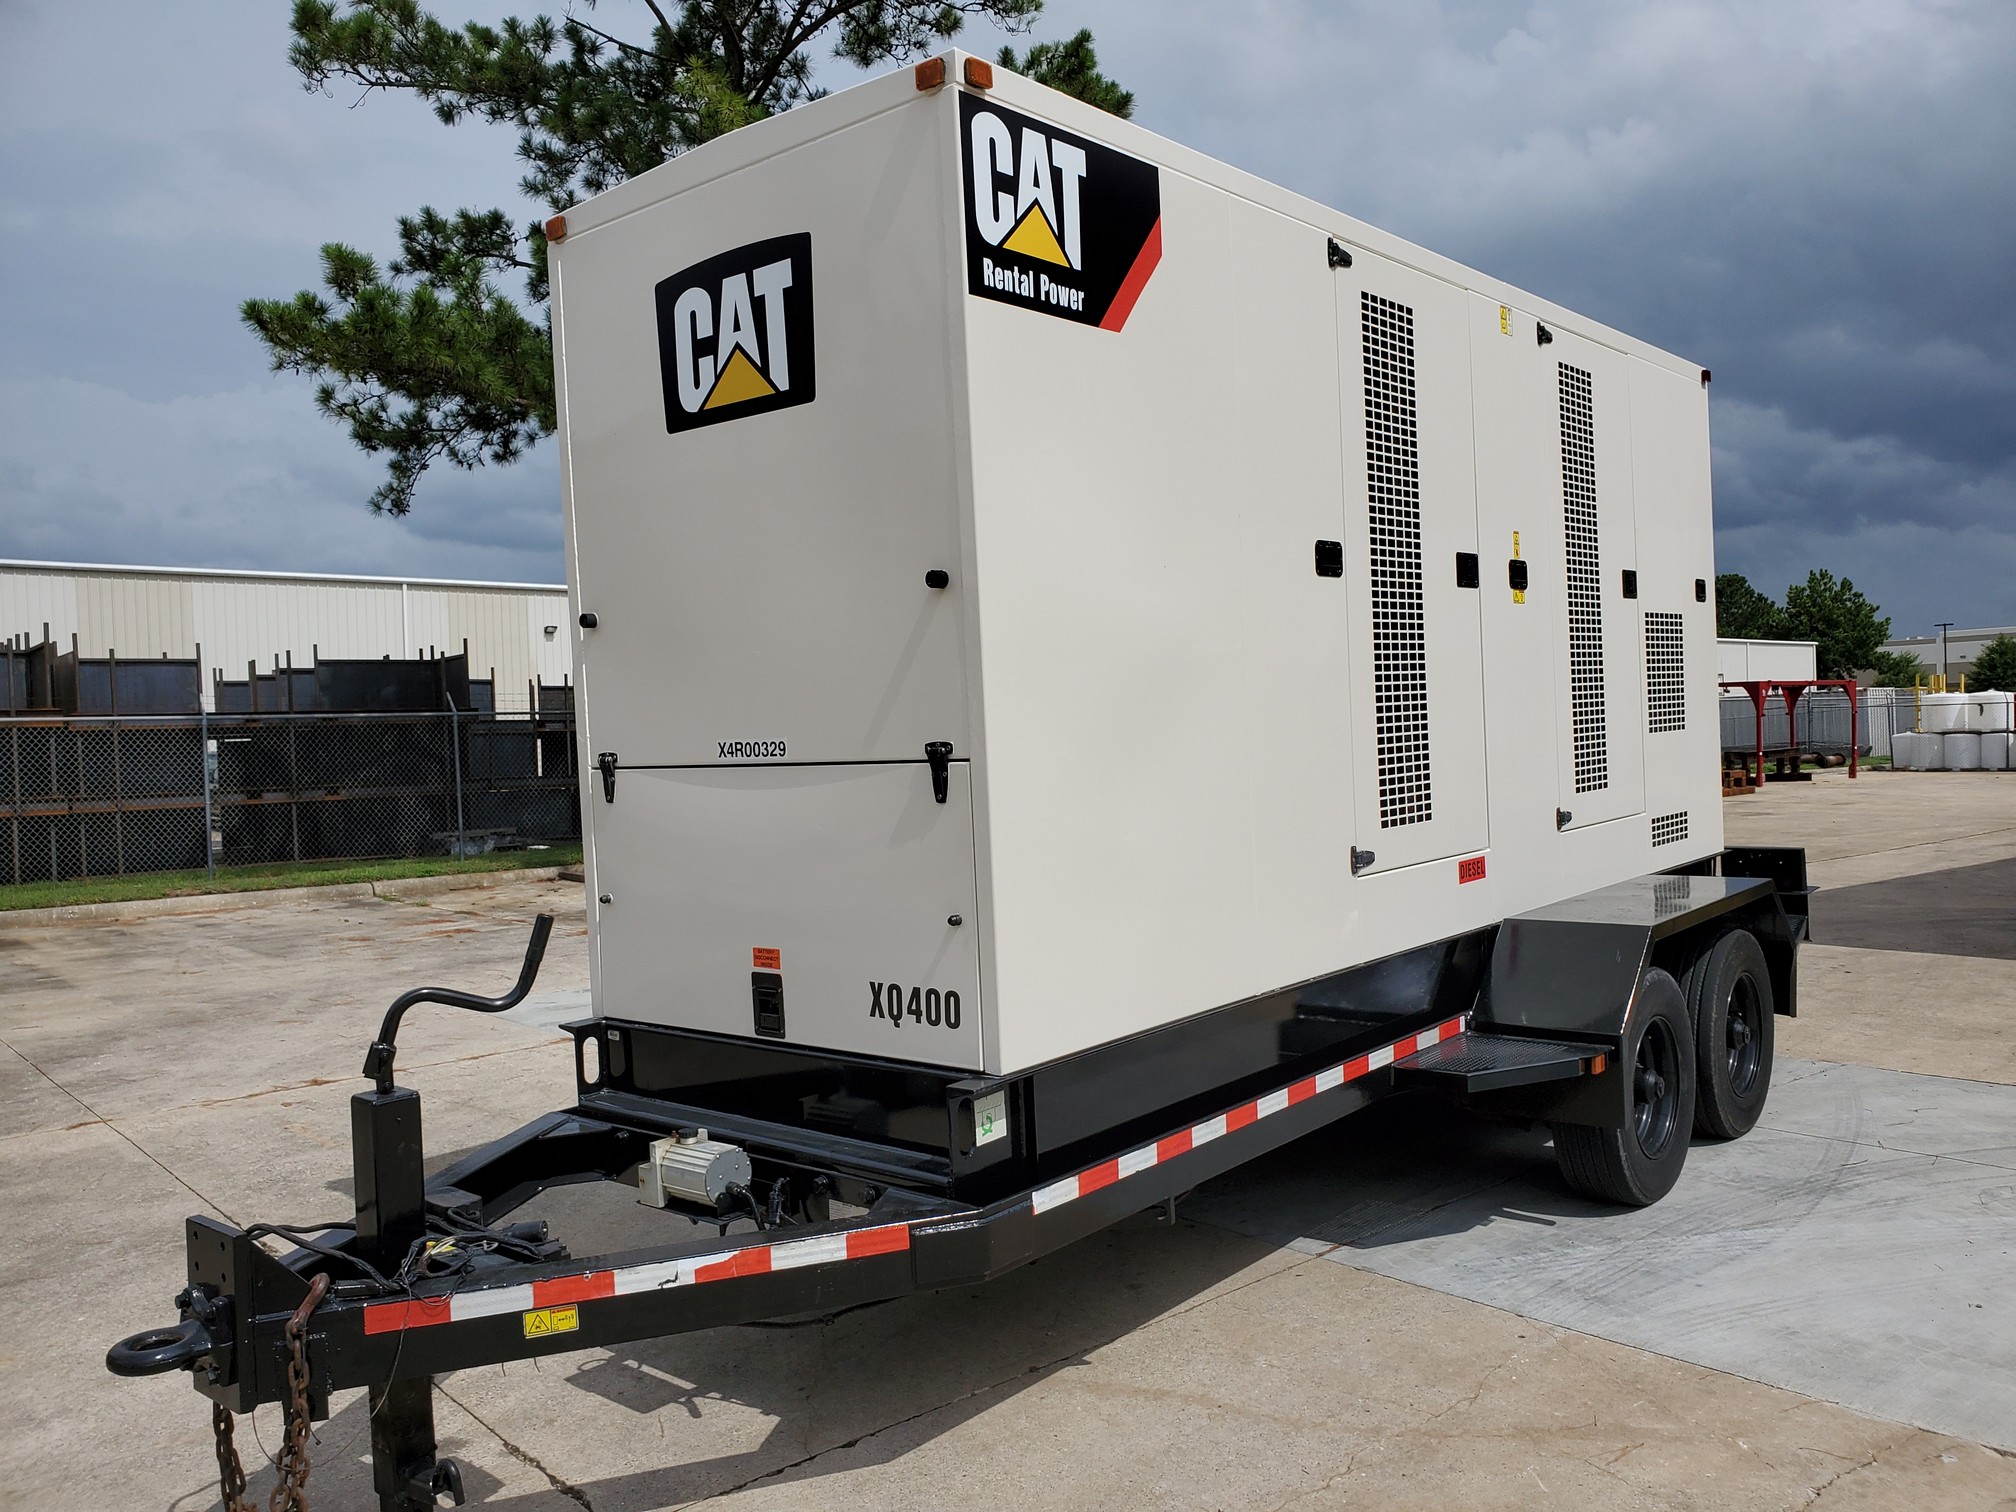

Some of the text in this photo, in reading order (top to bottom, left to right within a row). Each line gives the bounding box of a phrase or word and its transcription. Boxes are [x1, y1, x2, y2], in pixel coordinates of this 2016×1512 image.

[971, 111, 1087, 271] CAT
[983, 257, 1085, 311] Rental Power
[674, 258, 793, 413] CAT
[717, 740, 787, 758] X4R00329
[1460, 859, 1485, 879] DIESEL
[869, 981, 961, 1029] XQ400
